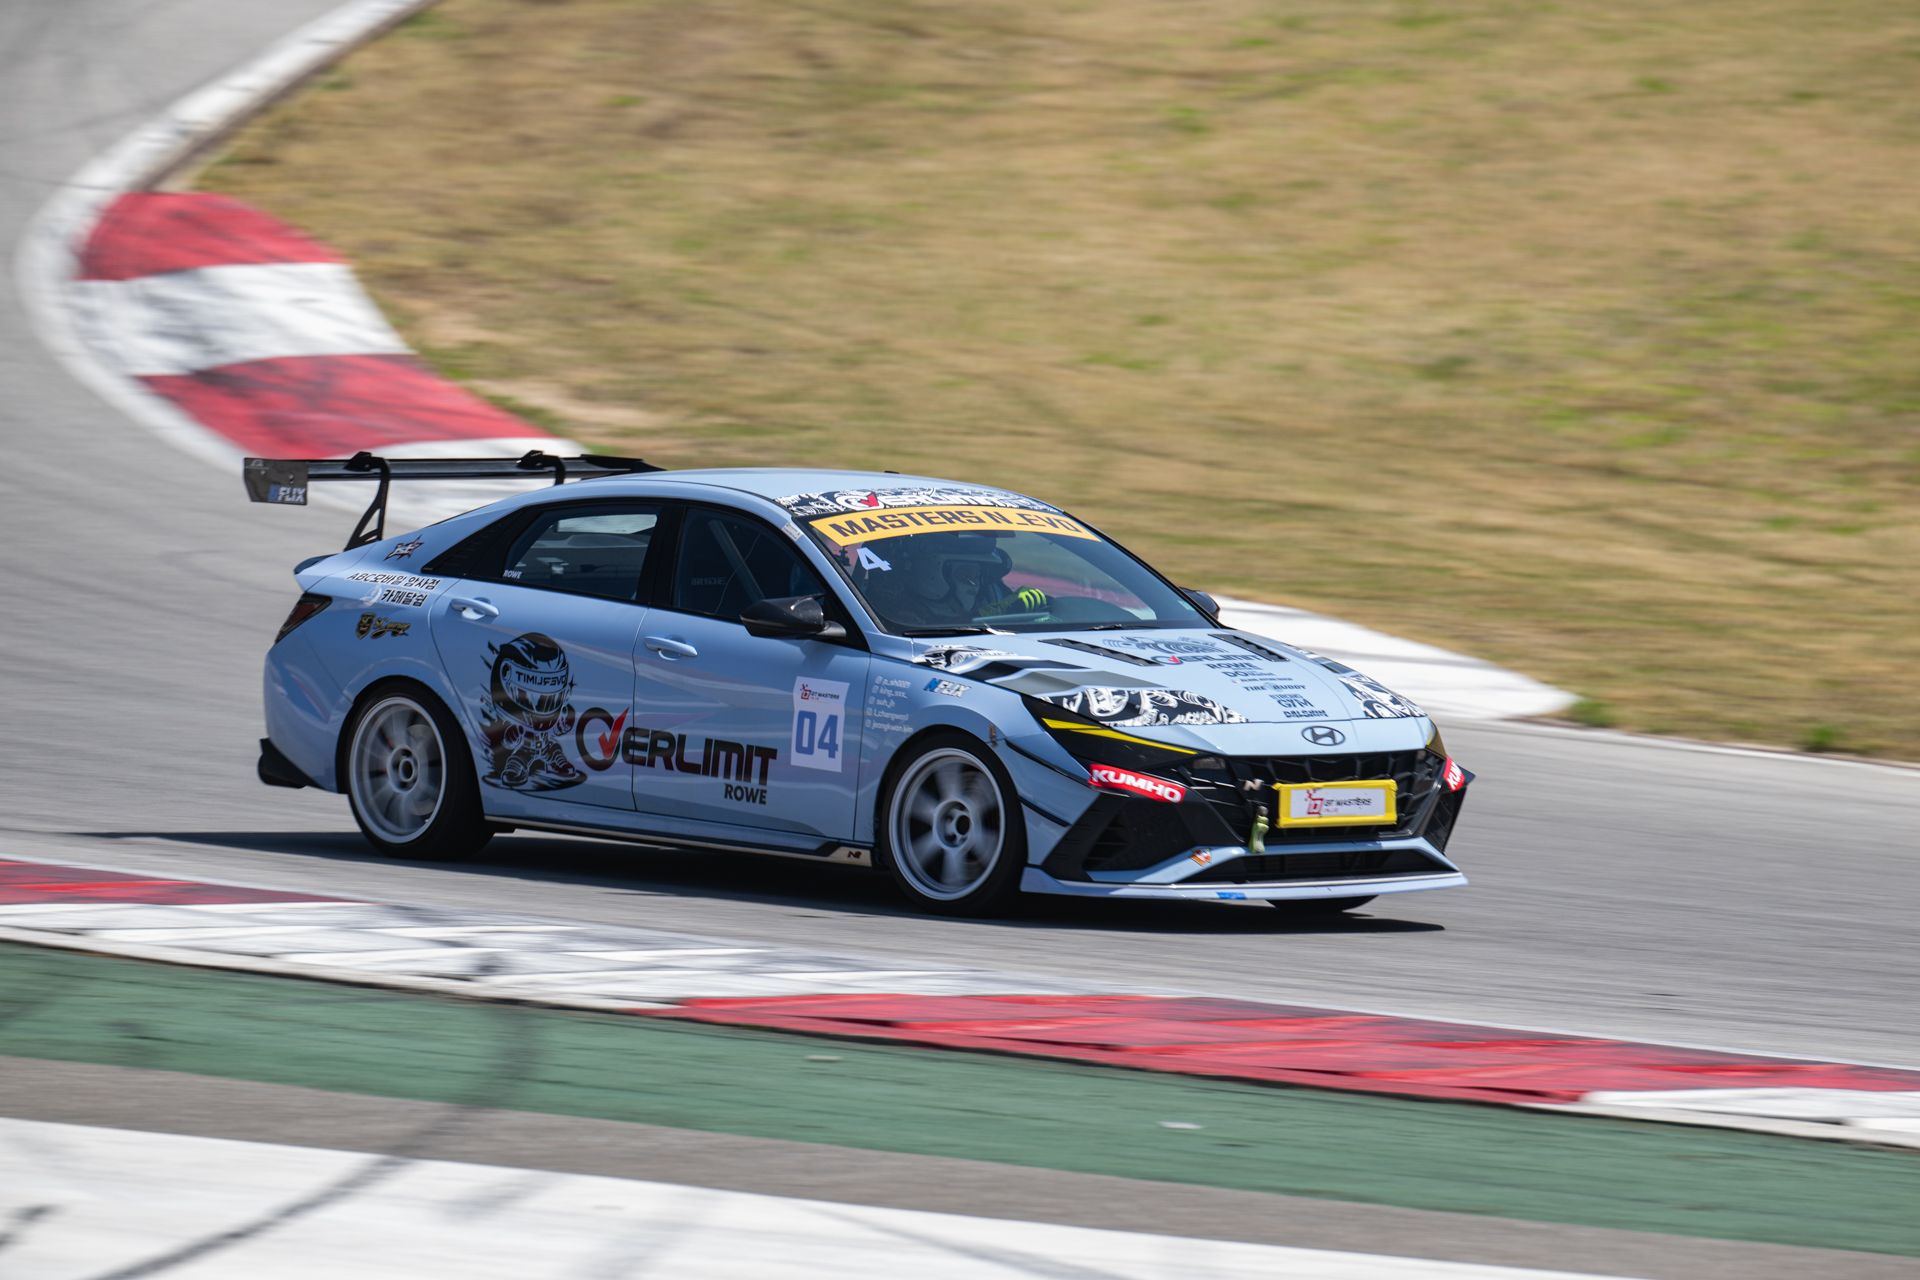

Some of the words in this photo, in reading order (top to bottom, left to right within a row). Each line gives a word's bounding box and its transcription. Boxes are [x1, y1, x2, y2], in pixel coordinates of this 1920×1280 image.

[831, 510, 985, 538] MASTERS
[985, 510, 1083, 533] N_EVO
[856, 547, 893, 573] 4
[503, 569, 522, 580] ROWE
[795, 710, 838, 759] 04
[723, 782, 768, 805] ROWE
[1091, 769, 1183, 803] KUMHO
